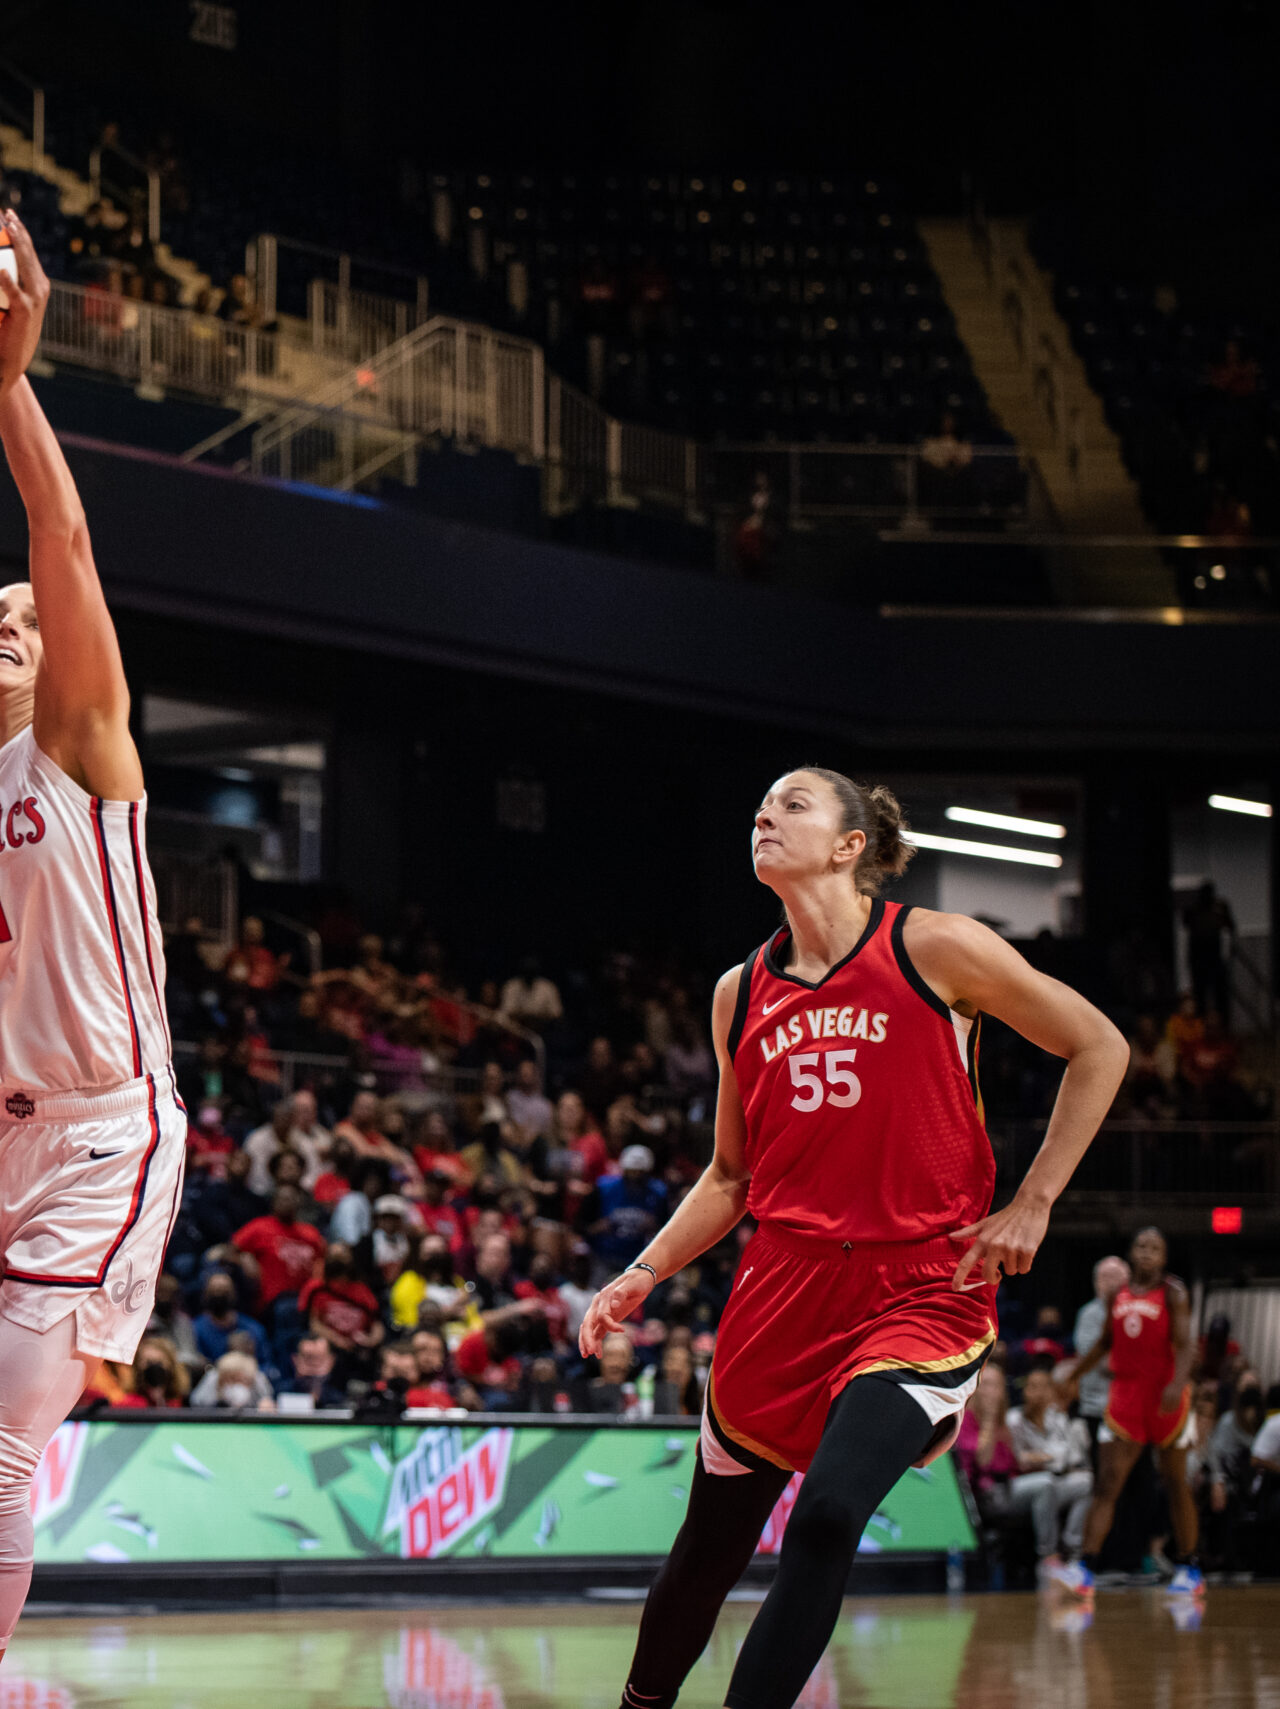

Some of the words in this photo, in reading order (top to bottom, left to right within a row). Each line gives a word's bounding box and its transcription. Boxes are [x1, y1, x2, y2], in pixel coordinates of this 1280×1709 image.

[760, 1014, 804, 1064] LAS
[805, 1005, 889, 1043] VEGAS
[788, 1048, 862, 1113] 55
